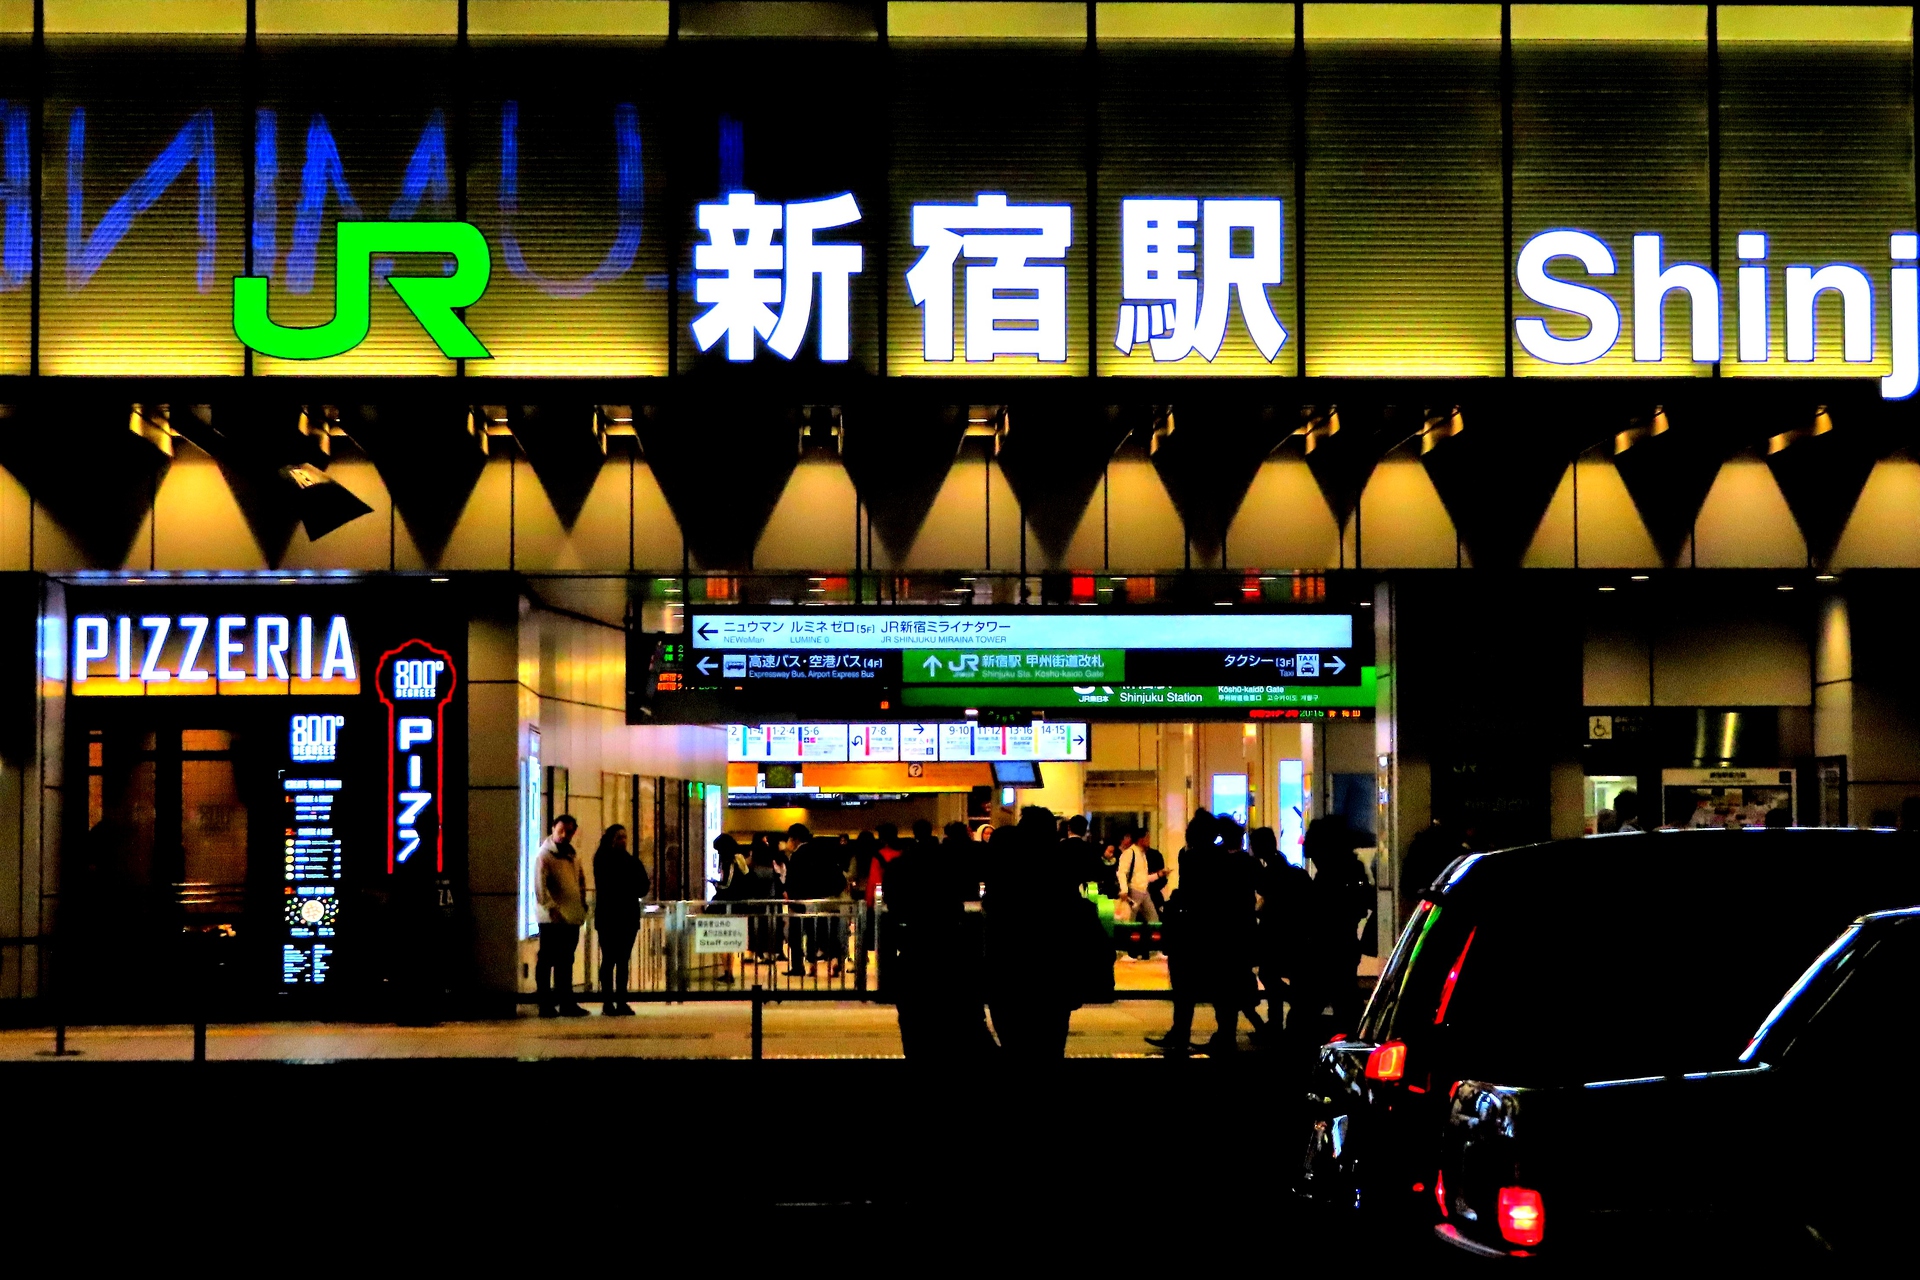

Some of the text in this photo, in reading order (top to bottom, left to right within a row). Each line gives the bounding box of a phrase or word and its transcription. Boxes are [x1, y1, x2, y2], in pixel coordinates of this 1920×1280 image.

[691, 191, 1288, 364] 新宿駅
[233, 221, 494, 360] JR
[1514, 227, 1920, 400] Shinj
[724, 621, 784, 633] ニュウマン
[790, 621, 828, 633] ルミネ
[831, 621, 855, 633] ゼロ
[881, 621, 1011, 633] JR新宿ミライナタワー
[75, 616, 357, 681] PIZZERIA
[749, 655, 862, 668] 高速バス・空港バス
[948, 654, 979, 671] JR
[982, 654, 1104, 668] 新宿駅 甲州街道改札
[1224, 654, 1274, 667] タクシー
[749, 670, 790, 679] Expressway
[808, 670, 831, 679] Airport
[832, 670, 860, 679] Express
[860, 670, 875, 678] Bus
[982, 669, 1016, 679] Shinjuku
[1084, 670, 1104, 678] Gate
[1279, 669, 1294, 677] Taxi
[396, 688, 436, 698] DEGREES
[1119, 692, 1203, 704] Shinjuku Station
[723, 939, 743, 948] only
